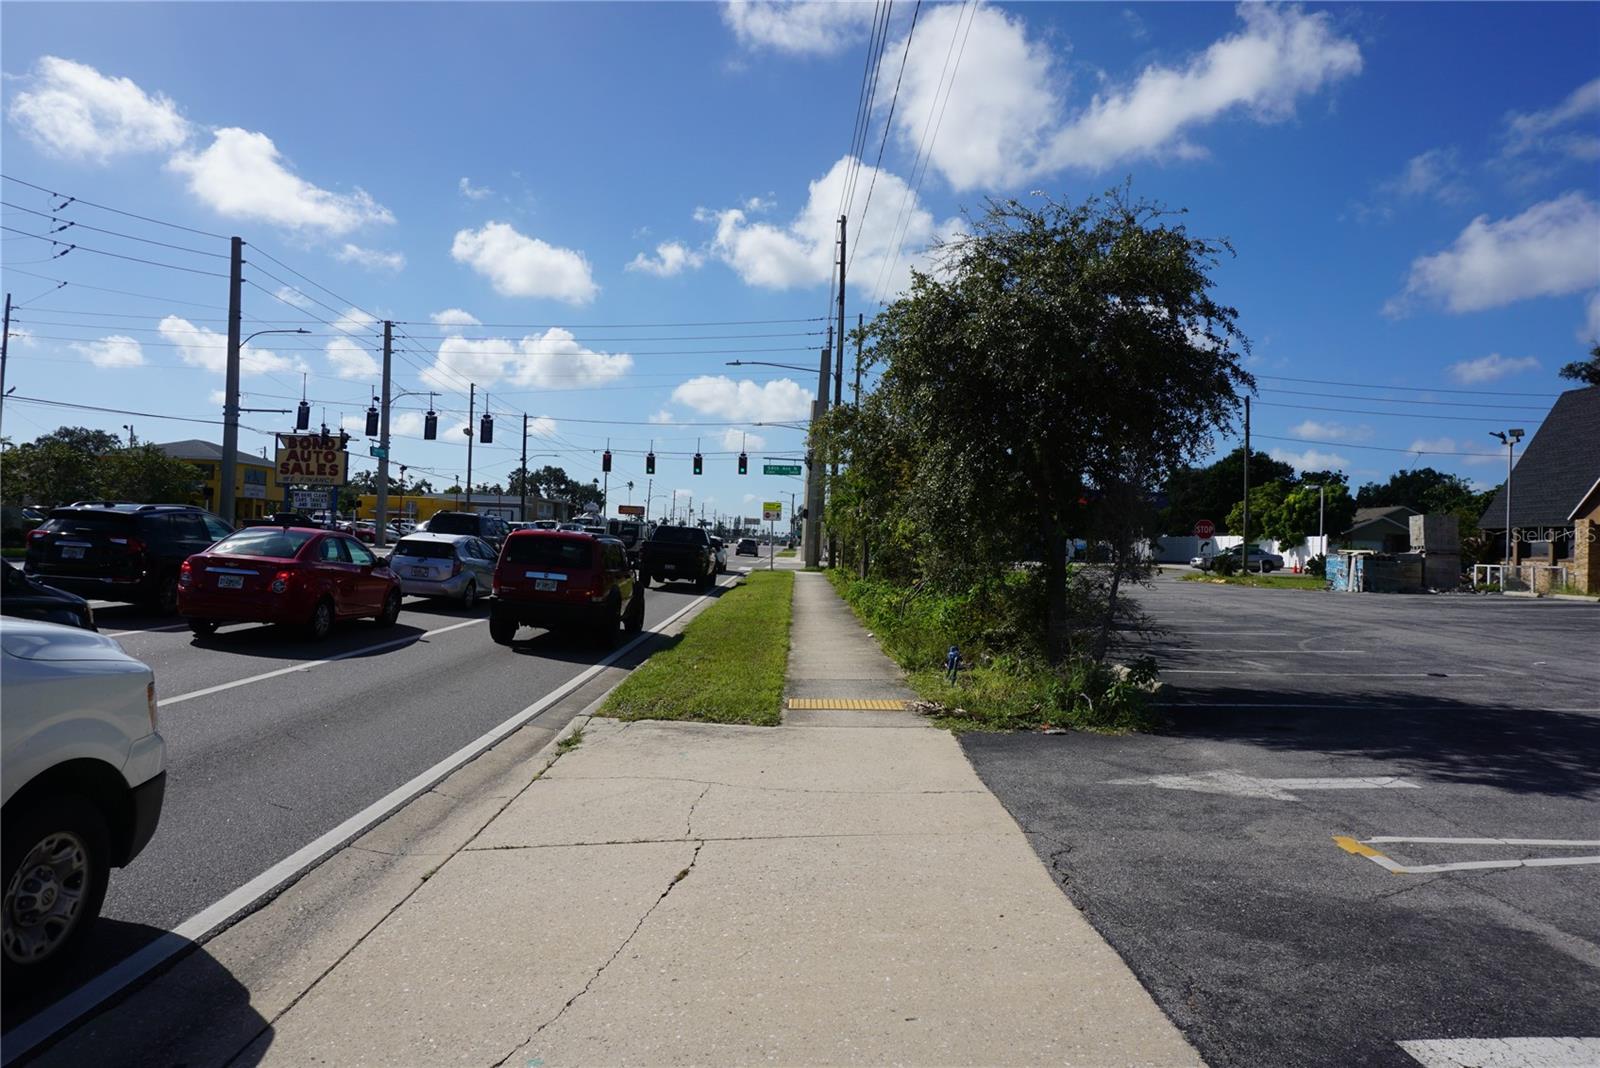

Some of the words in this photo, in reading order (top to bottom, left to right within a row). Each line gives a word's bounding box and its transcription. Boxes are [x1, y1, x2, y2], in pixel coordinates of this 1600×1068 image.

[286, 450, 336, 464] AUTO
[280, 463, 338, 476] SALES
[1196, 525, 1214, 534] STOP
